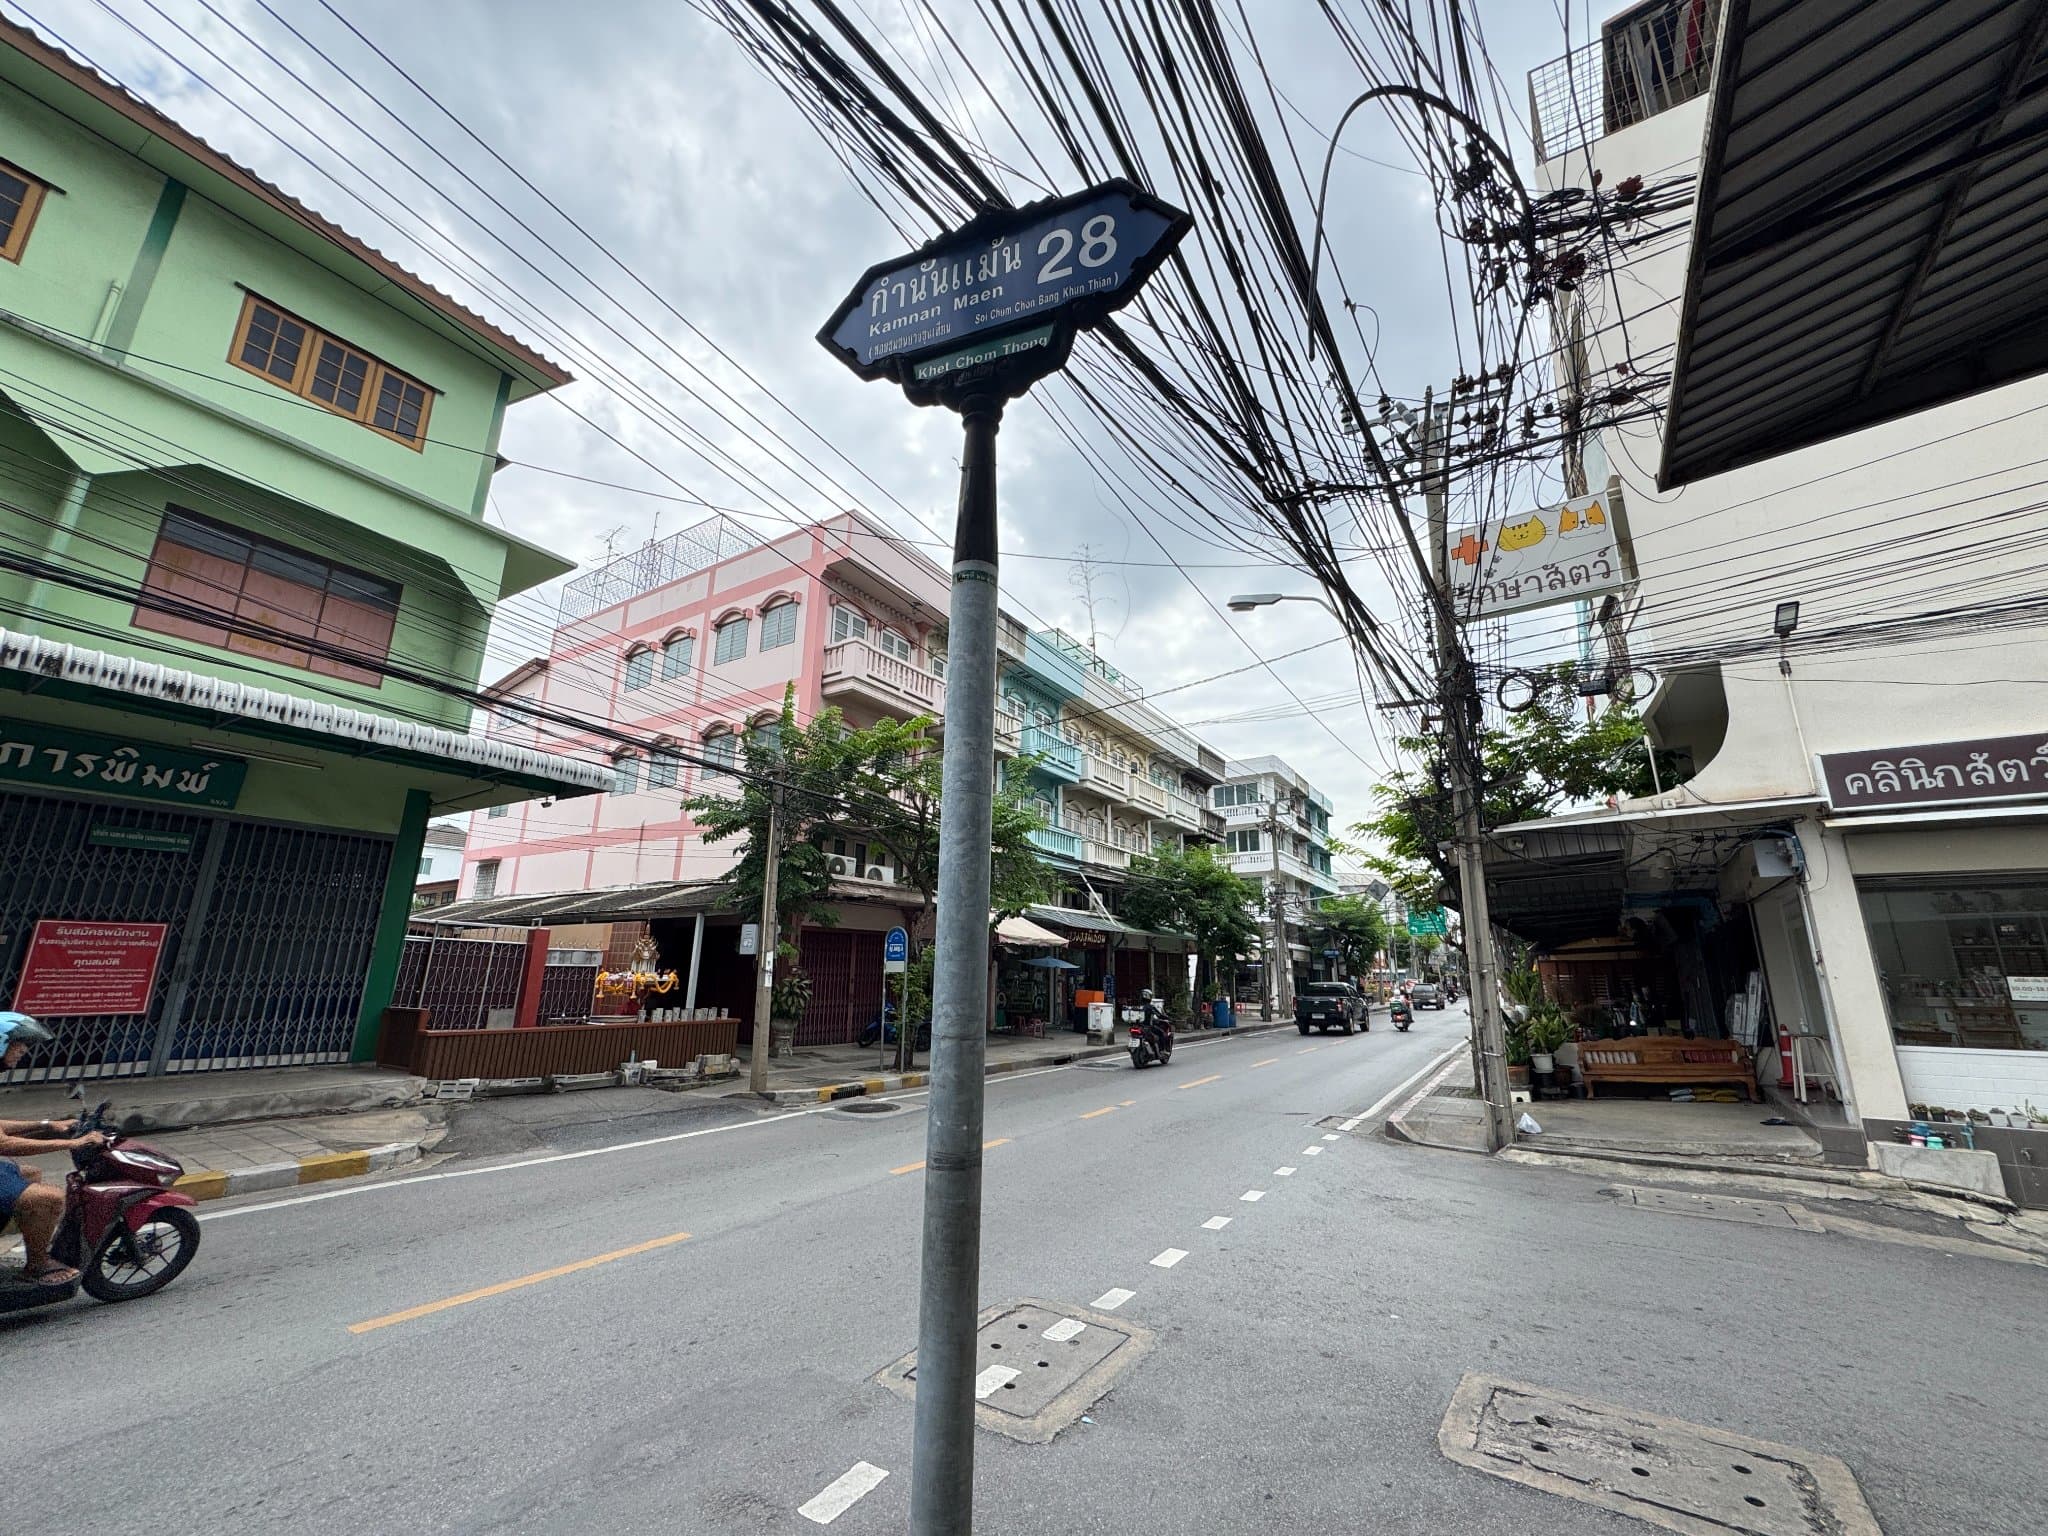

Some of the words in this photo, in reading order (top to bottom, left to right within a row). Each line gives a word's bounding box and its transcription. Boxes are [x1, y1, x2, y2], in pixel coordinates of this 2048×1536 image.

[870, 236, 1023, 318] กำนันแม้น
[1036, 214, 1119, 285] 28
[869, 305, 942, 337] Kamnan
[953, 284, 1005, 312] Maen
[974, 312, 988, 325] Soi
[990, 305, 1012, 320] Chum
[1038, 291, 1060, 306] Bang
[1062, 283, 1086, 298] Khun
[917, 361, 950, 381] Khet
[955, 348, 998, 370] Chom
[1002, 335, 1049, 356] Thong
[1452, 546, 1612, 609] รักษาสัตว์
[55, 926, 150, 937] รับสมัครพนักงาน
[72, 957, 121, 968] คุณสมบัติ
